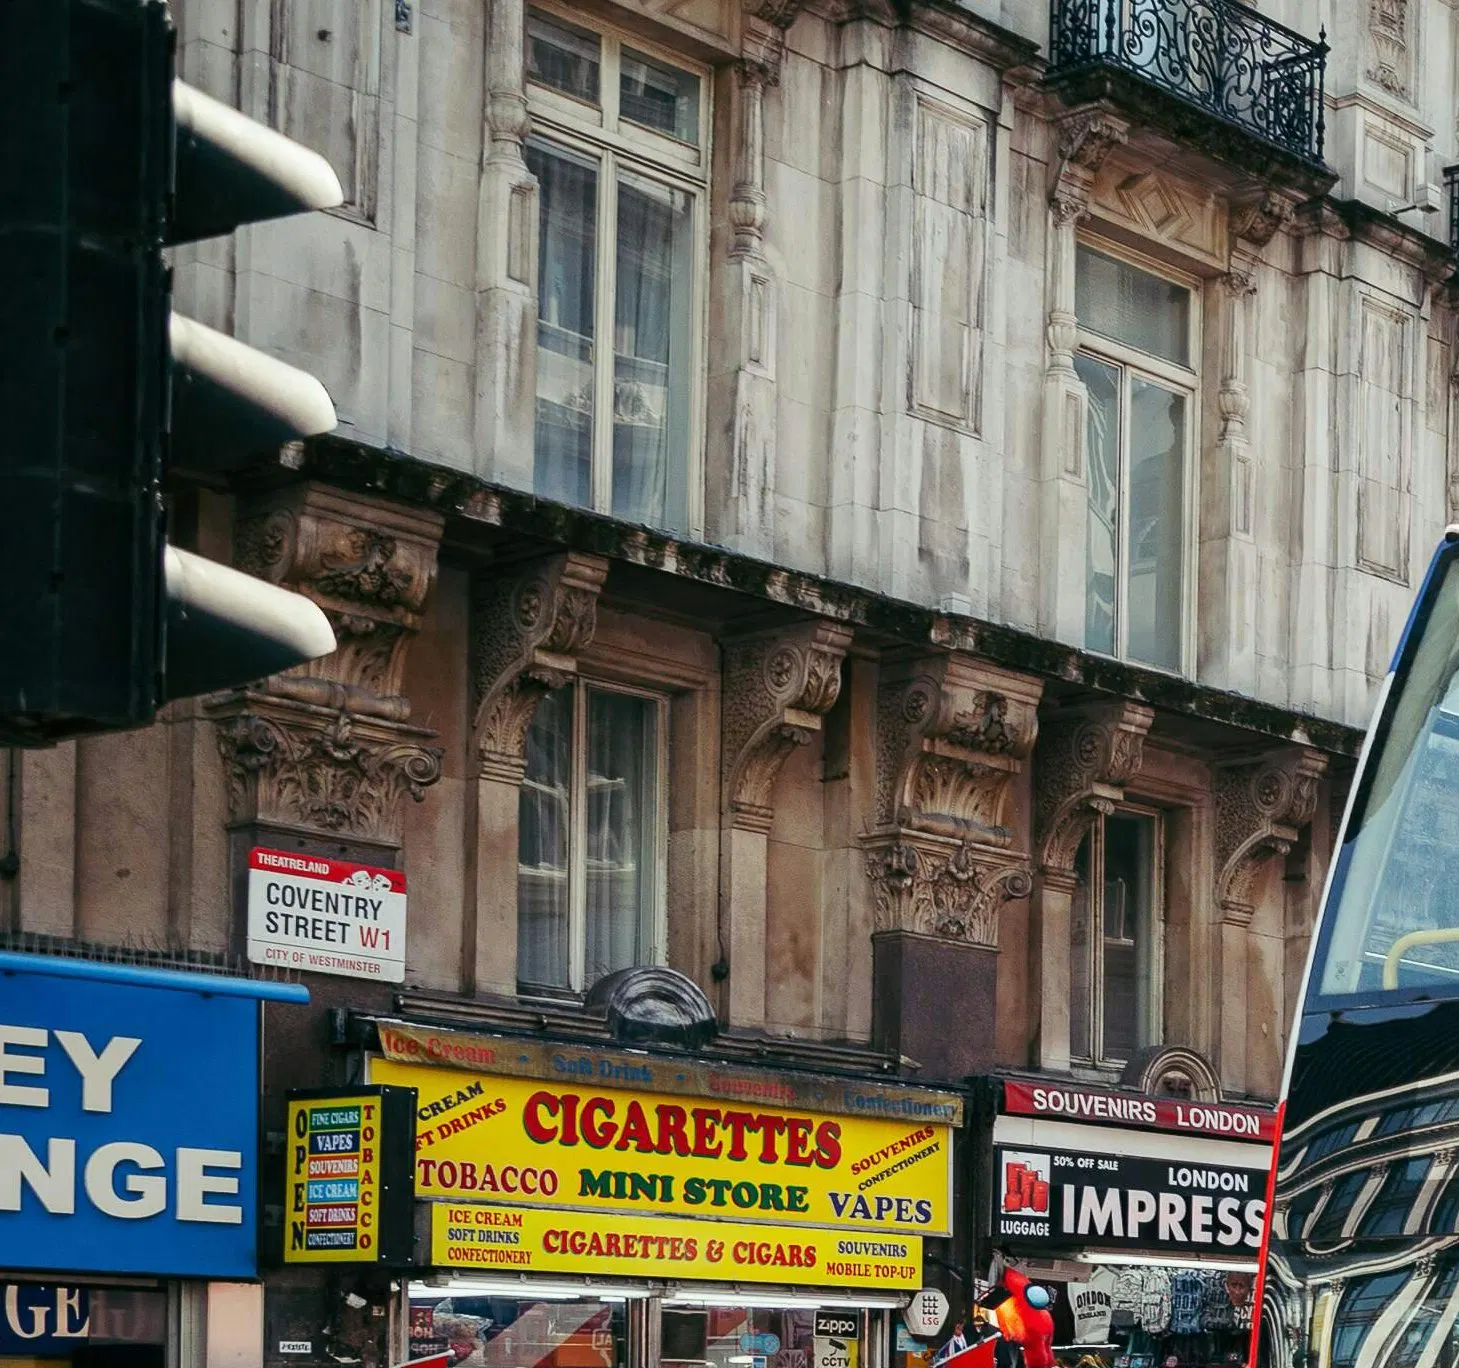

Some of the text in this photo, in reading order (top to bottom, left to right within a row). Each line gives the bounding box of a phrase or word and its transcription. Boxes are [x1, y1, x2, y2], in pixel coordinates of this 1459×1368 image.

[257, 853, 329, 875] THEATRELAND
[266, 882, 383, 921] COVENTRY
[266, 911, 390, 951] STREET W1
[266, 948, 381, 974] CITY OF WESTMINSTER
[384, 1031, 497, 1065] Ice Cream
[418, 1081, 485, 1122] CREAM
[1032, 1089, 1260, 1135] SOUVENIRS LONDON
[311, 1109, 359, 1127] FINE CIGARS
[435, 1098, 507, 1141] DRINKS
[523, 1091, 842, 1170] CIGARETTES
[317, 1134, 353, 1151] VAPES
[851, 1125, 935, 1176] SOUVENIRS
[310, 1159, 358, 1172] SOUVENIRS
[858, 1141, 941, 1191] CONFECTIONERY
[1053, 1156, 1119, 1171] 50% OFF SALE
[291, 1109, 307, 1250] OPEN
[359, 1104, 375, 1249] TOBACCO
[1168, 1167, 1249, 1192] LONDON
[309, 1182, 357, 1198] ICE CREAM
[418, 1158, 932, 1224] TOBACCO MINI STORE VAPES
[309, 1207, 356, 1223] SOFT DRINKS
[449, 1210, 523, 1227] ICE CREAM
[1062, 1183, 1268, 1248] IMPRESS
[308, 1232, 355, 1246] CONFECTIONERY
[448, 1228, 520, 1244] SOFT DRINKS
[1000, 1220, 1050, 1237] LUGGAGE
[447, 1247, 533, 1264] CONFECTIONERY
[542, 1229, 817, 1268] CIGARETTES & CIGARS
[838, 1241, 907, 1258] SOUVENIRS
[826, 1262, 916, 1280] MOBILE TOP-UP
[817, 1318, 855, 1334] zippo
[922, 1317, 940, 1326] LSG
[822, 1357, 850, 1368] CCTV
